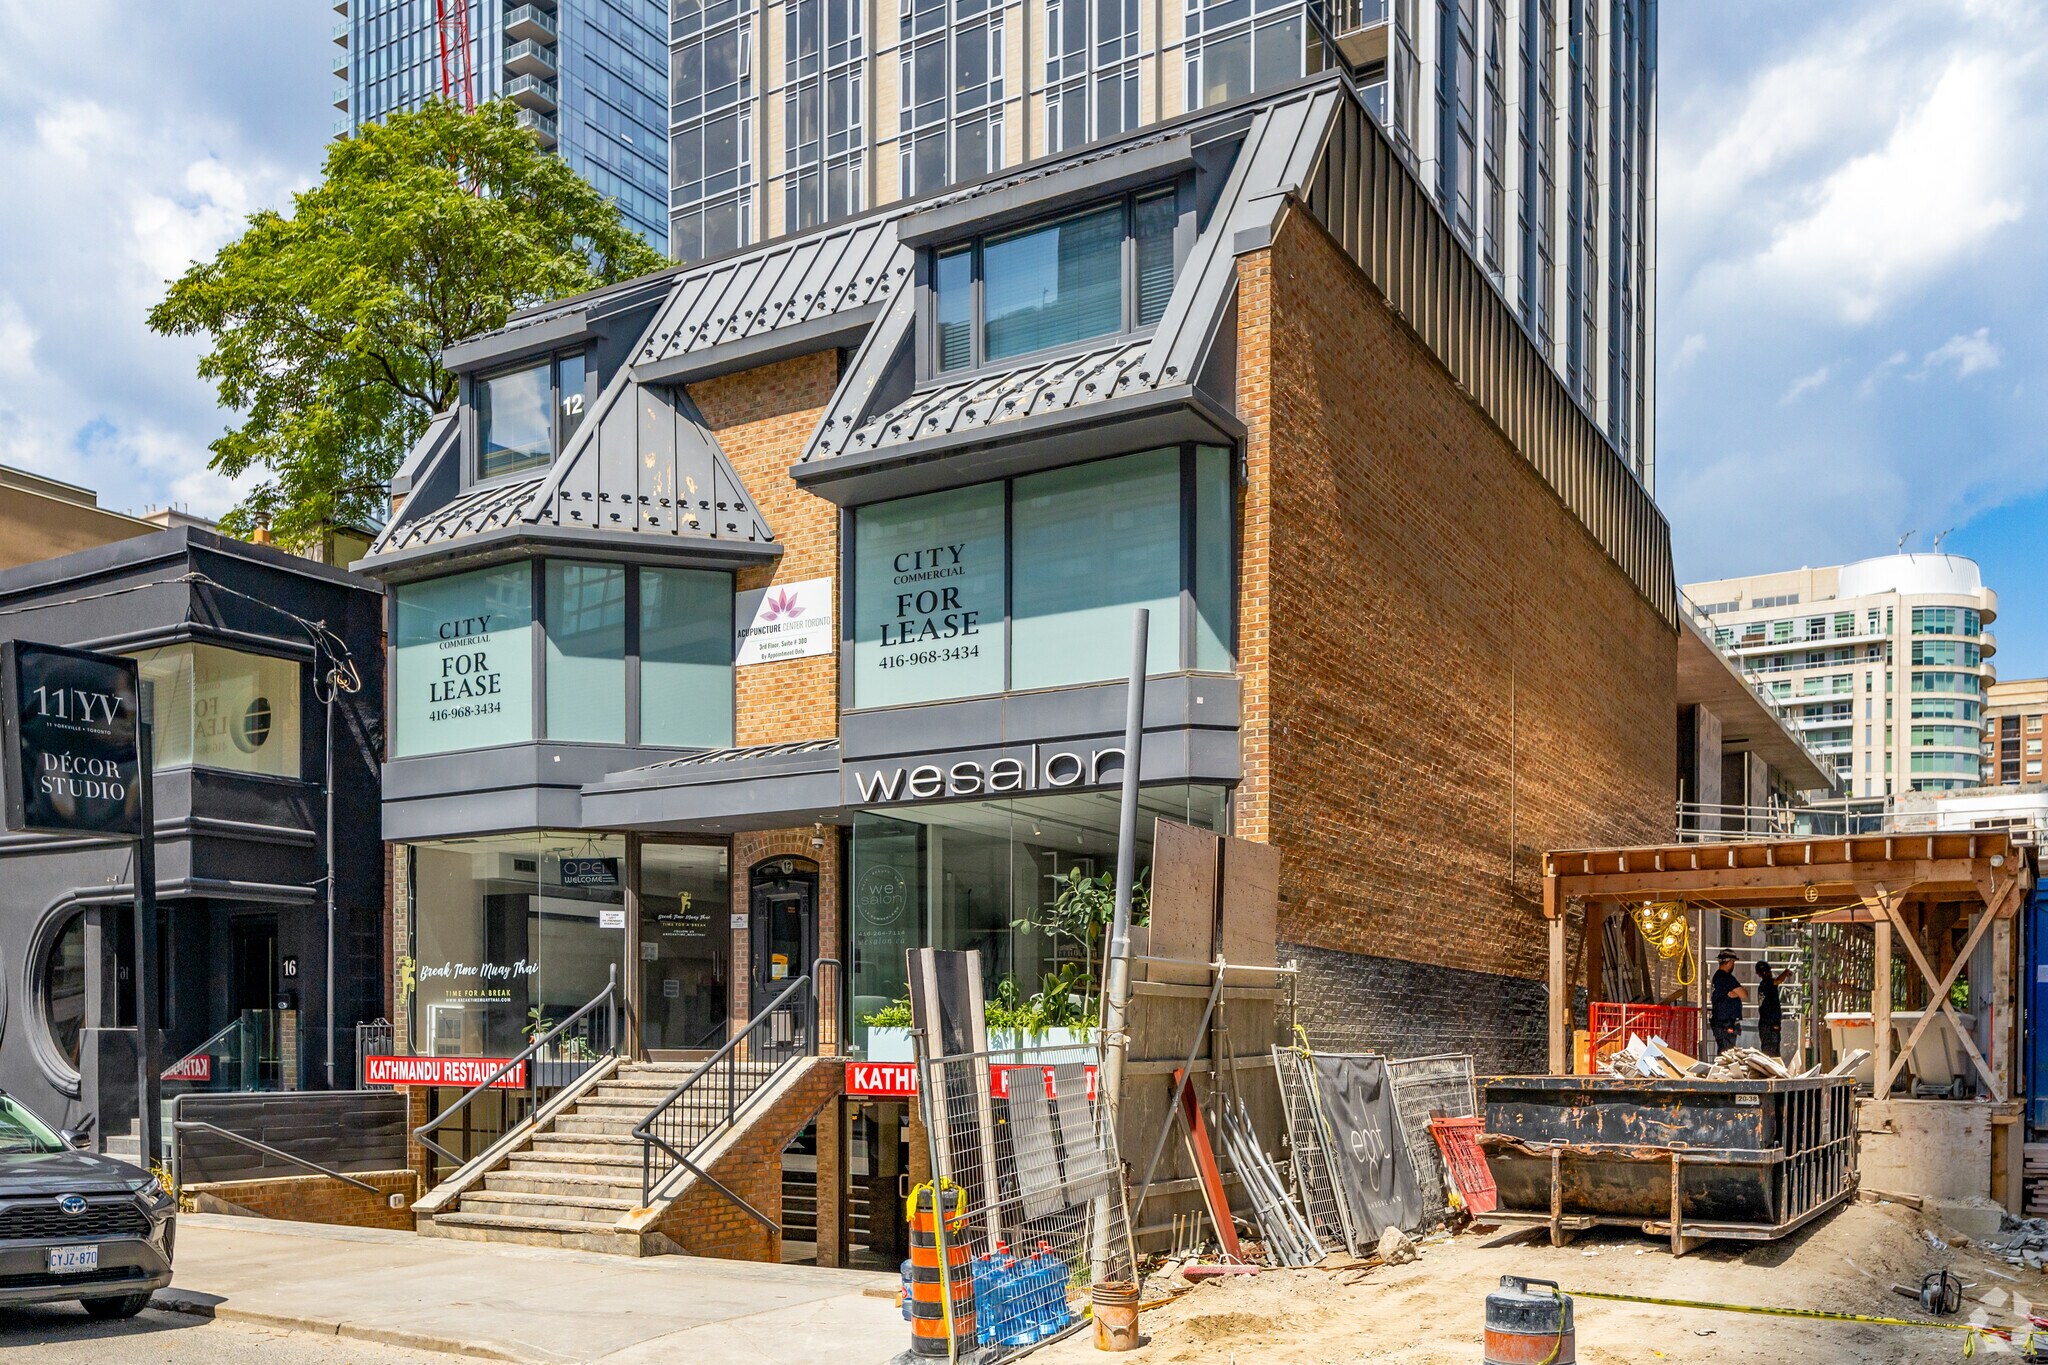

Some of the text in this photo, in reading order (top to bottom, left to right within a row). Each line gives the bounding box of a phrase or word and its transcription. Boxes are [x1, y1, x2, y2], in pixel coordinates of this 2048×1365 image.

[563, 393, 583, 416] 12
[893, 543, 966, 573] CITY
[893, 566, 966, 585] COMMERCIAL
[896, 586, 963, 618] FOR
[439, 615, 491, 640] CITY
[737, 616, 831, 639] ACUPUNCTURE CENTER TORONTO
[879, 610, 980, 648] LEASE
[439, 635, 491, 650] COMMERCIAL
[441, 652, 489, 678] FOR
[878, 644, 980, 669] 416-968-3434
[429, 673, 501, 703] LEASE
[429, 701, 501, 722] 416-968-3434
[54, 723, 81, 732] YORKVILLE
[87, 727, 112, 736] TORONTO
[42, 750, 121, 779] DÉCOR
[854, 743, 1126, 802] wesalon
[41, 775, 125, 801] STUDIO
[783, 860, 792, 872] 12
[564, 876, 603, 884] WELCOME
[869, 884, 894, 894] we
[860, 893, 903, 906] salon
[283, 959, 297, 976] 16
[419, 958, 539, 981] Break Time Muay Thai
[370, 1060, 522, 1083] KATHMANDU RESTAURANT
